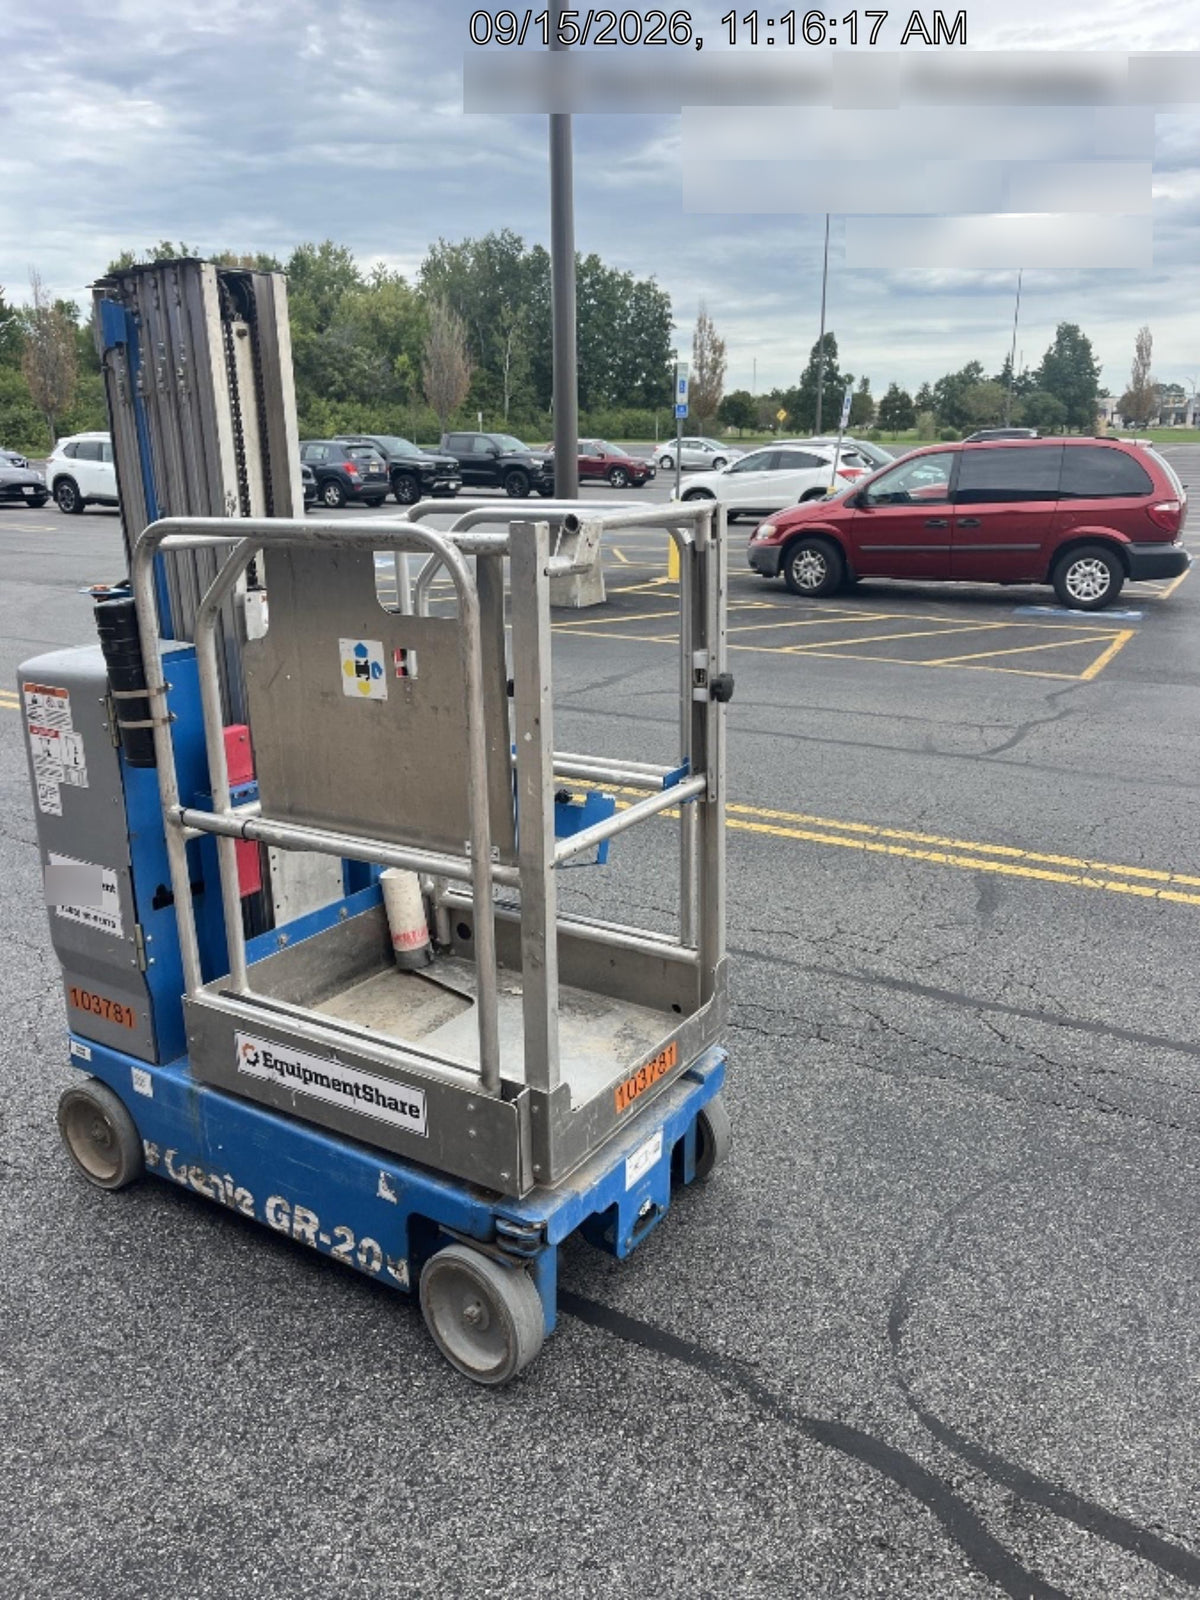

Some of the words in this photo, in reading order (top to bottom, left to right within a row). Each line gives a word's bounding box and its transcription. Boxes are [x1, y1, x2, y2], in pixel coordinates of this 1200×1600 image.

[69, 987, 133, 1028] 103781
[261, 1050, 421, 1119] EquipmentShare
[617, 1046, 675, 1108] 103781
